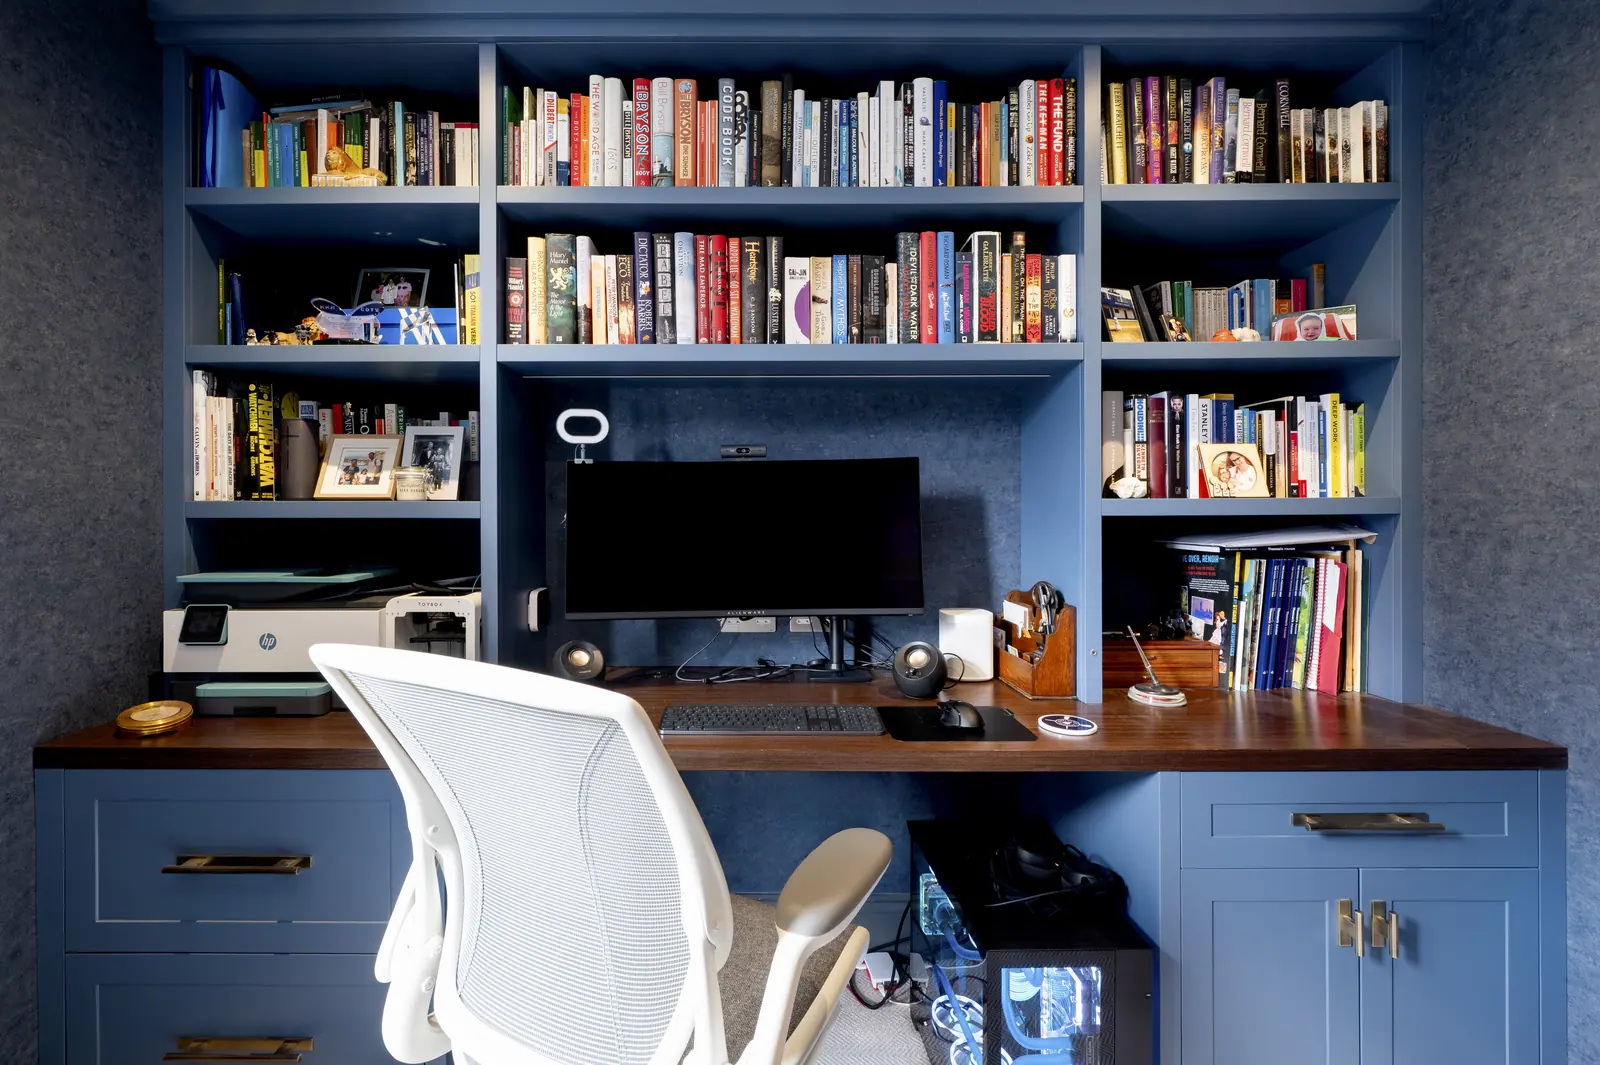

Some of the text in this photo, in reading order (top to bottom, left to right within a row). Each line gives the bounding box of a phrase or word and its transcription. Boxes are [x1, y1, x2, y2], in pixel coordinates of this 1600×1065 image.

[592, 82, 600, 99] THE
[660, 82, 668, 96] Bill
[1279, 85, 1289, 127] CORNWELL
[547, 98, 555, 124] DILBERT
[636, 91, 649, 155] BRYSON
[658, 98, 668, 131] Bryson
[680, 100, 691, 144] BRYSON
[722, 85, 733, 166] CODE BOOK
[1026, 123, 1032, 132] Up
[1039, 84, 1047, 149] THE KEY MAN
[1053, 95, 1063, 152] THE FUND
[1114, 87, 1123, 149] TERRY PRATCHETT
[592, 136, 600, 155] AGE
[1068, 136, 1076, 171] MICHAEL LEWIS
[1242, 101, 1252, 168] Bernard Cornwell
[1255, 103, 1267, 171] Bernard Cornwell
[619, 257, 627, 277] ECO
[638, 238, 648, 278] DICTATOR
[729, 241, 738, 273] HARPER LEE
[745, 241, 760, 283] Heartstone
[730, 290, 739, 299] SET
[837, 260, 845, 336] Stephen Fry MYTHOS
[910, 251, 918, 340] DEVIL DARK WATER
[979, 297, 989, 332] BLOOD
[988, 291, 996, 331] TROUBLED
[638, 299, 646, 331] HARRIS
[730, 306, 739, 338] WATCHMAN
[249, 392, 258, 432] WATCHMEN
[258, 399, 275, 487] WATCHMEN
[261, 633, 275, 651] hp
